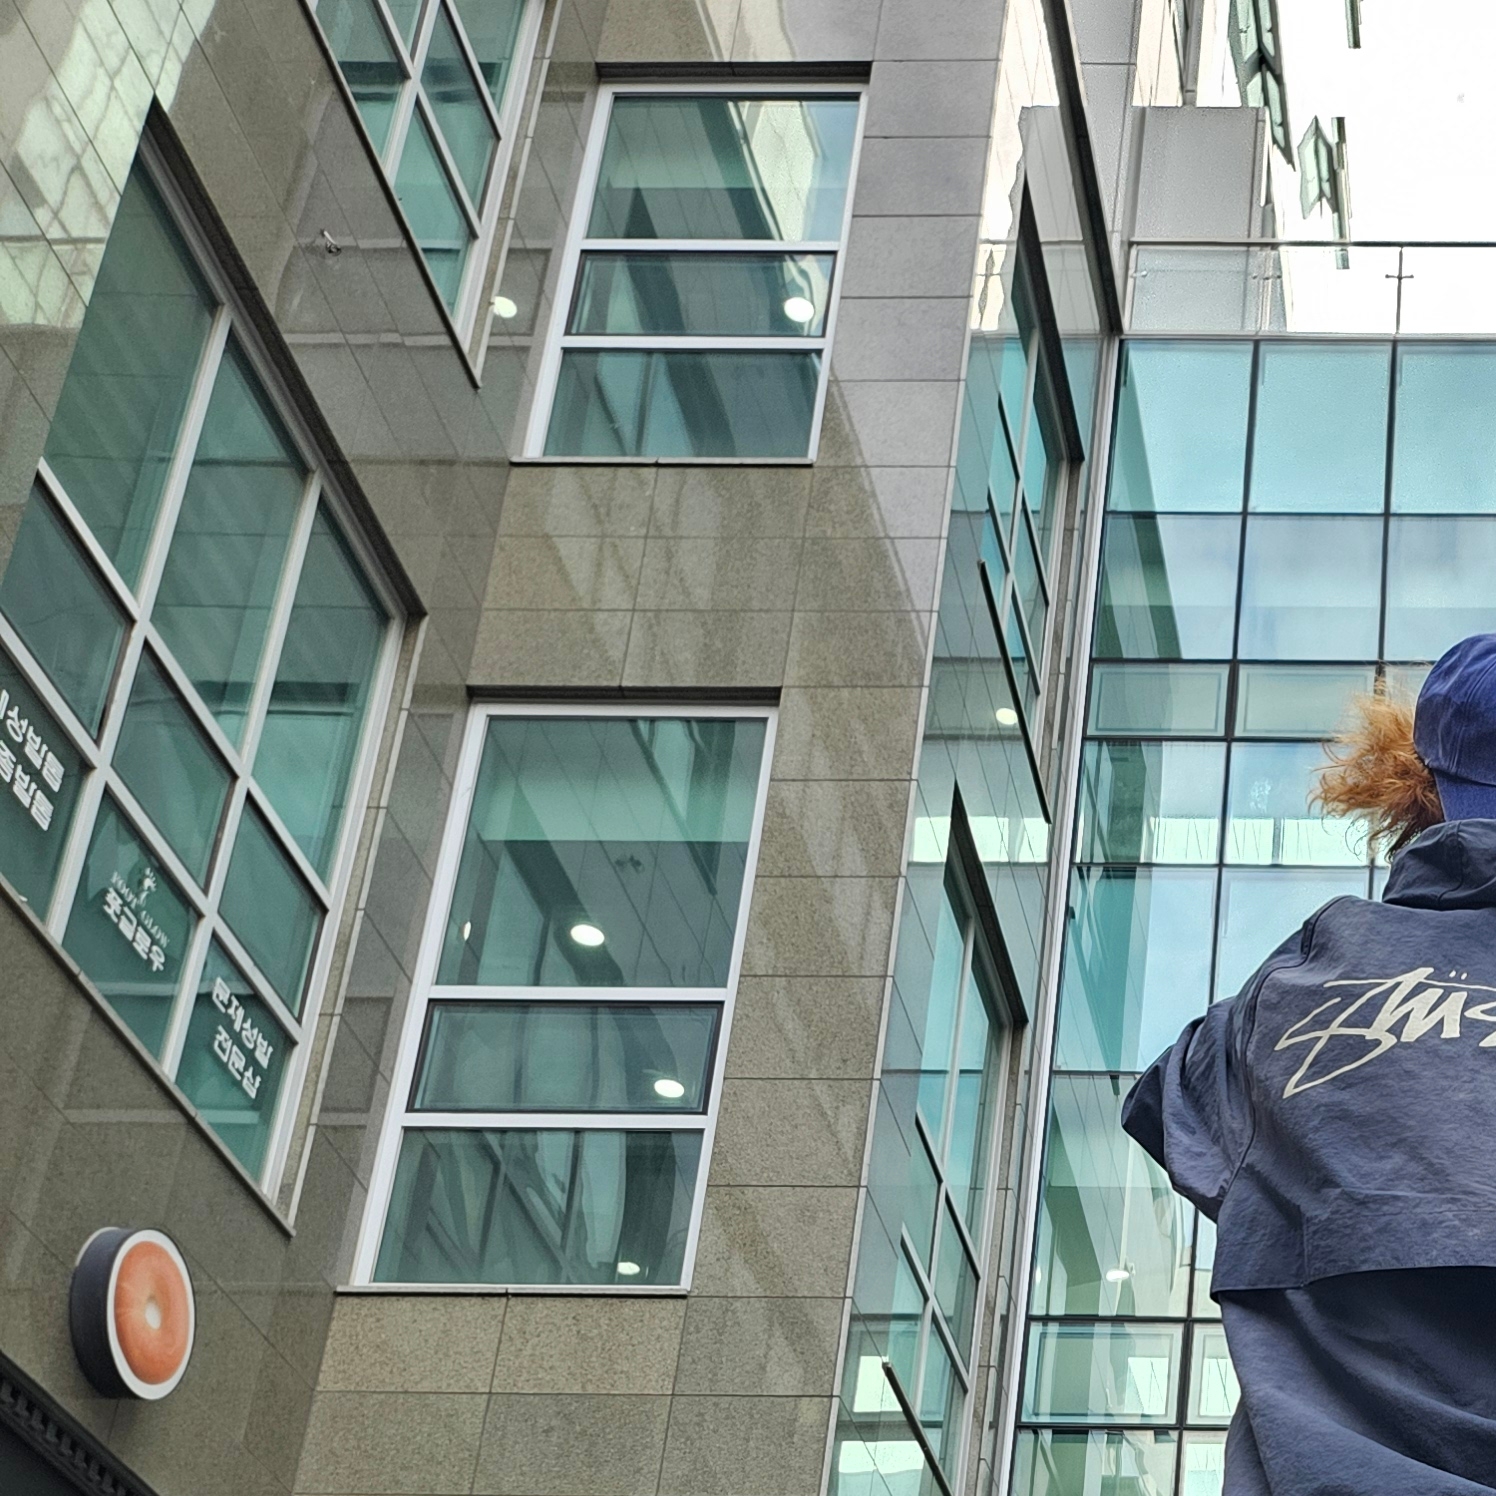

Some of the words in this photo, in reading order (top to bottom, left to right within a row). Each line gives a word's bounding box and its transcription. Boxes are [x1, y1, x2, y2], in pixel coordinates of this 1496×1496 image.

[101, 887, 166, 973] 풋글로우
[211, 975, 274, 1070] 문제성발
[213, 1025, 262, 1100] 전문샵
